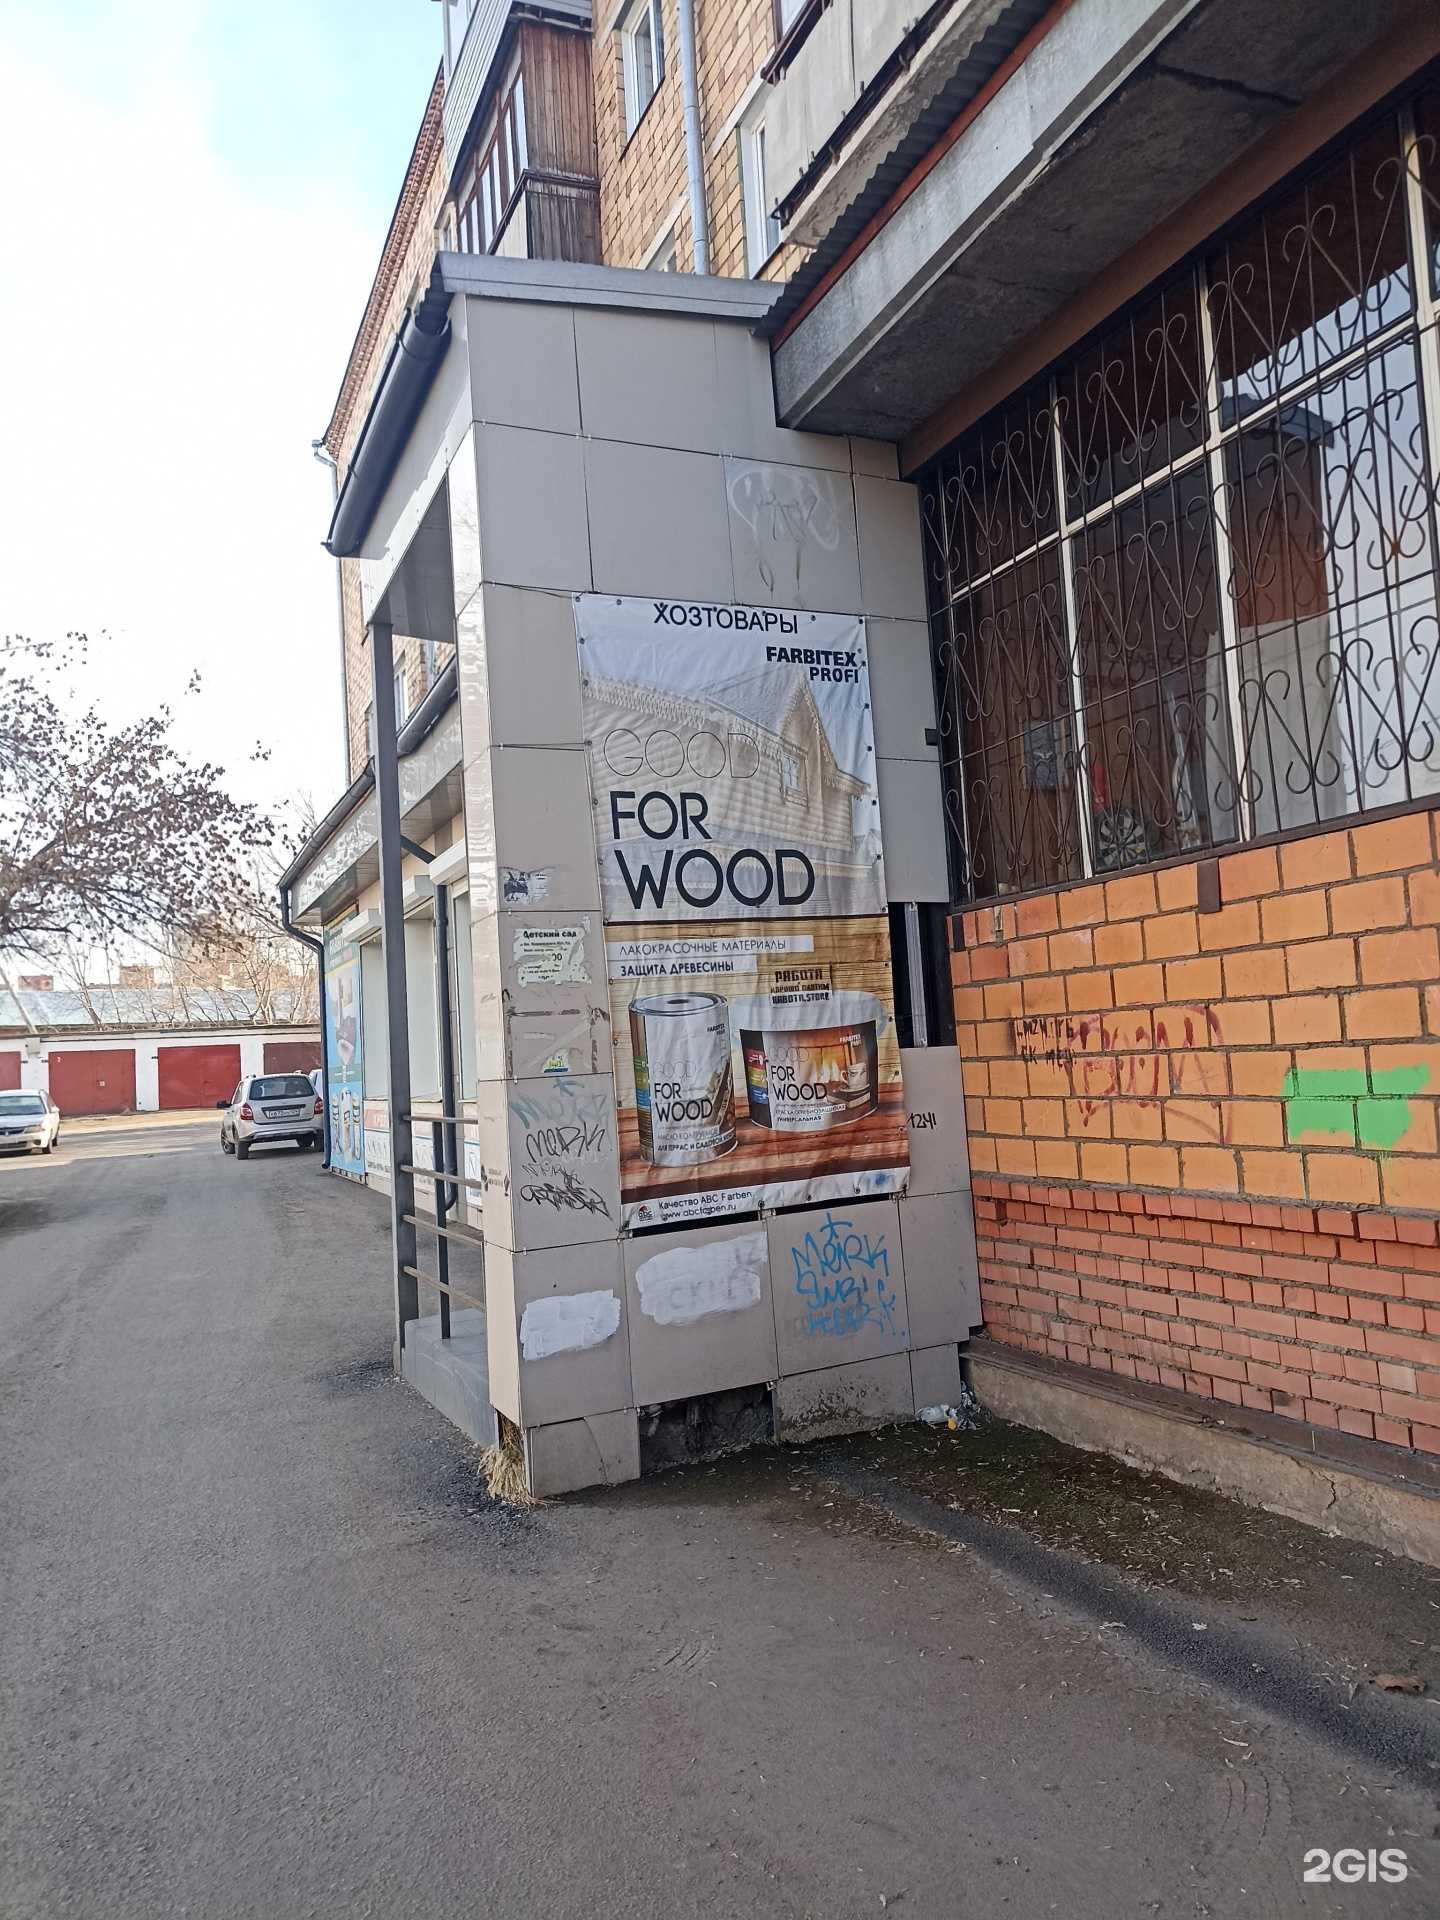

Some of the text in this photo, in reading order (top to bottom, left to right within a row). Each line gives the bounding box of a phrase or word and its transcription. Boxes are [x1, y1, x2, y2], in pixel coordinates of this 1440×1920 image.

[653, 603, 799, 634] ХОЗТОВАРЫ
[766, 646, 858, 668] FARBITEX
[809, 666, 860, 684] PROFI
[603, 728, 761, 779] GOOD
[609, 790, 713, 840] FOR
[613, 848, 816, 910] WOOD
[619, 939, 787, 957] ЛАКОКРАСОЧНЫЕ МАТЕРИАЛЫ
[620, 960, 735, 977] ЗАЩИТА ДРЕВЕСИНЫ
[775, 968, 823, 983] РАБОТА
[770, 1065, 796, 1082] FOR
[653, 1082, 682, 1100] FOR
[772, 1082, 828, 1101] WOOD
[654, 1098, 714, 1123] WOOD
[659, 1190, 753, 1210] Качество ABC Farben
